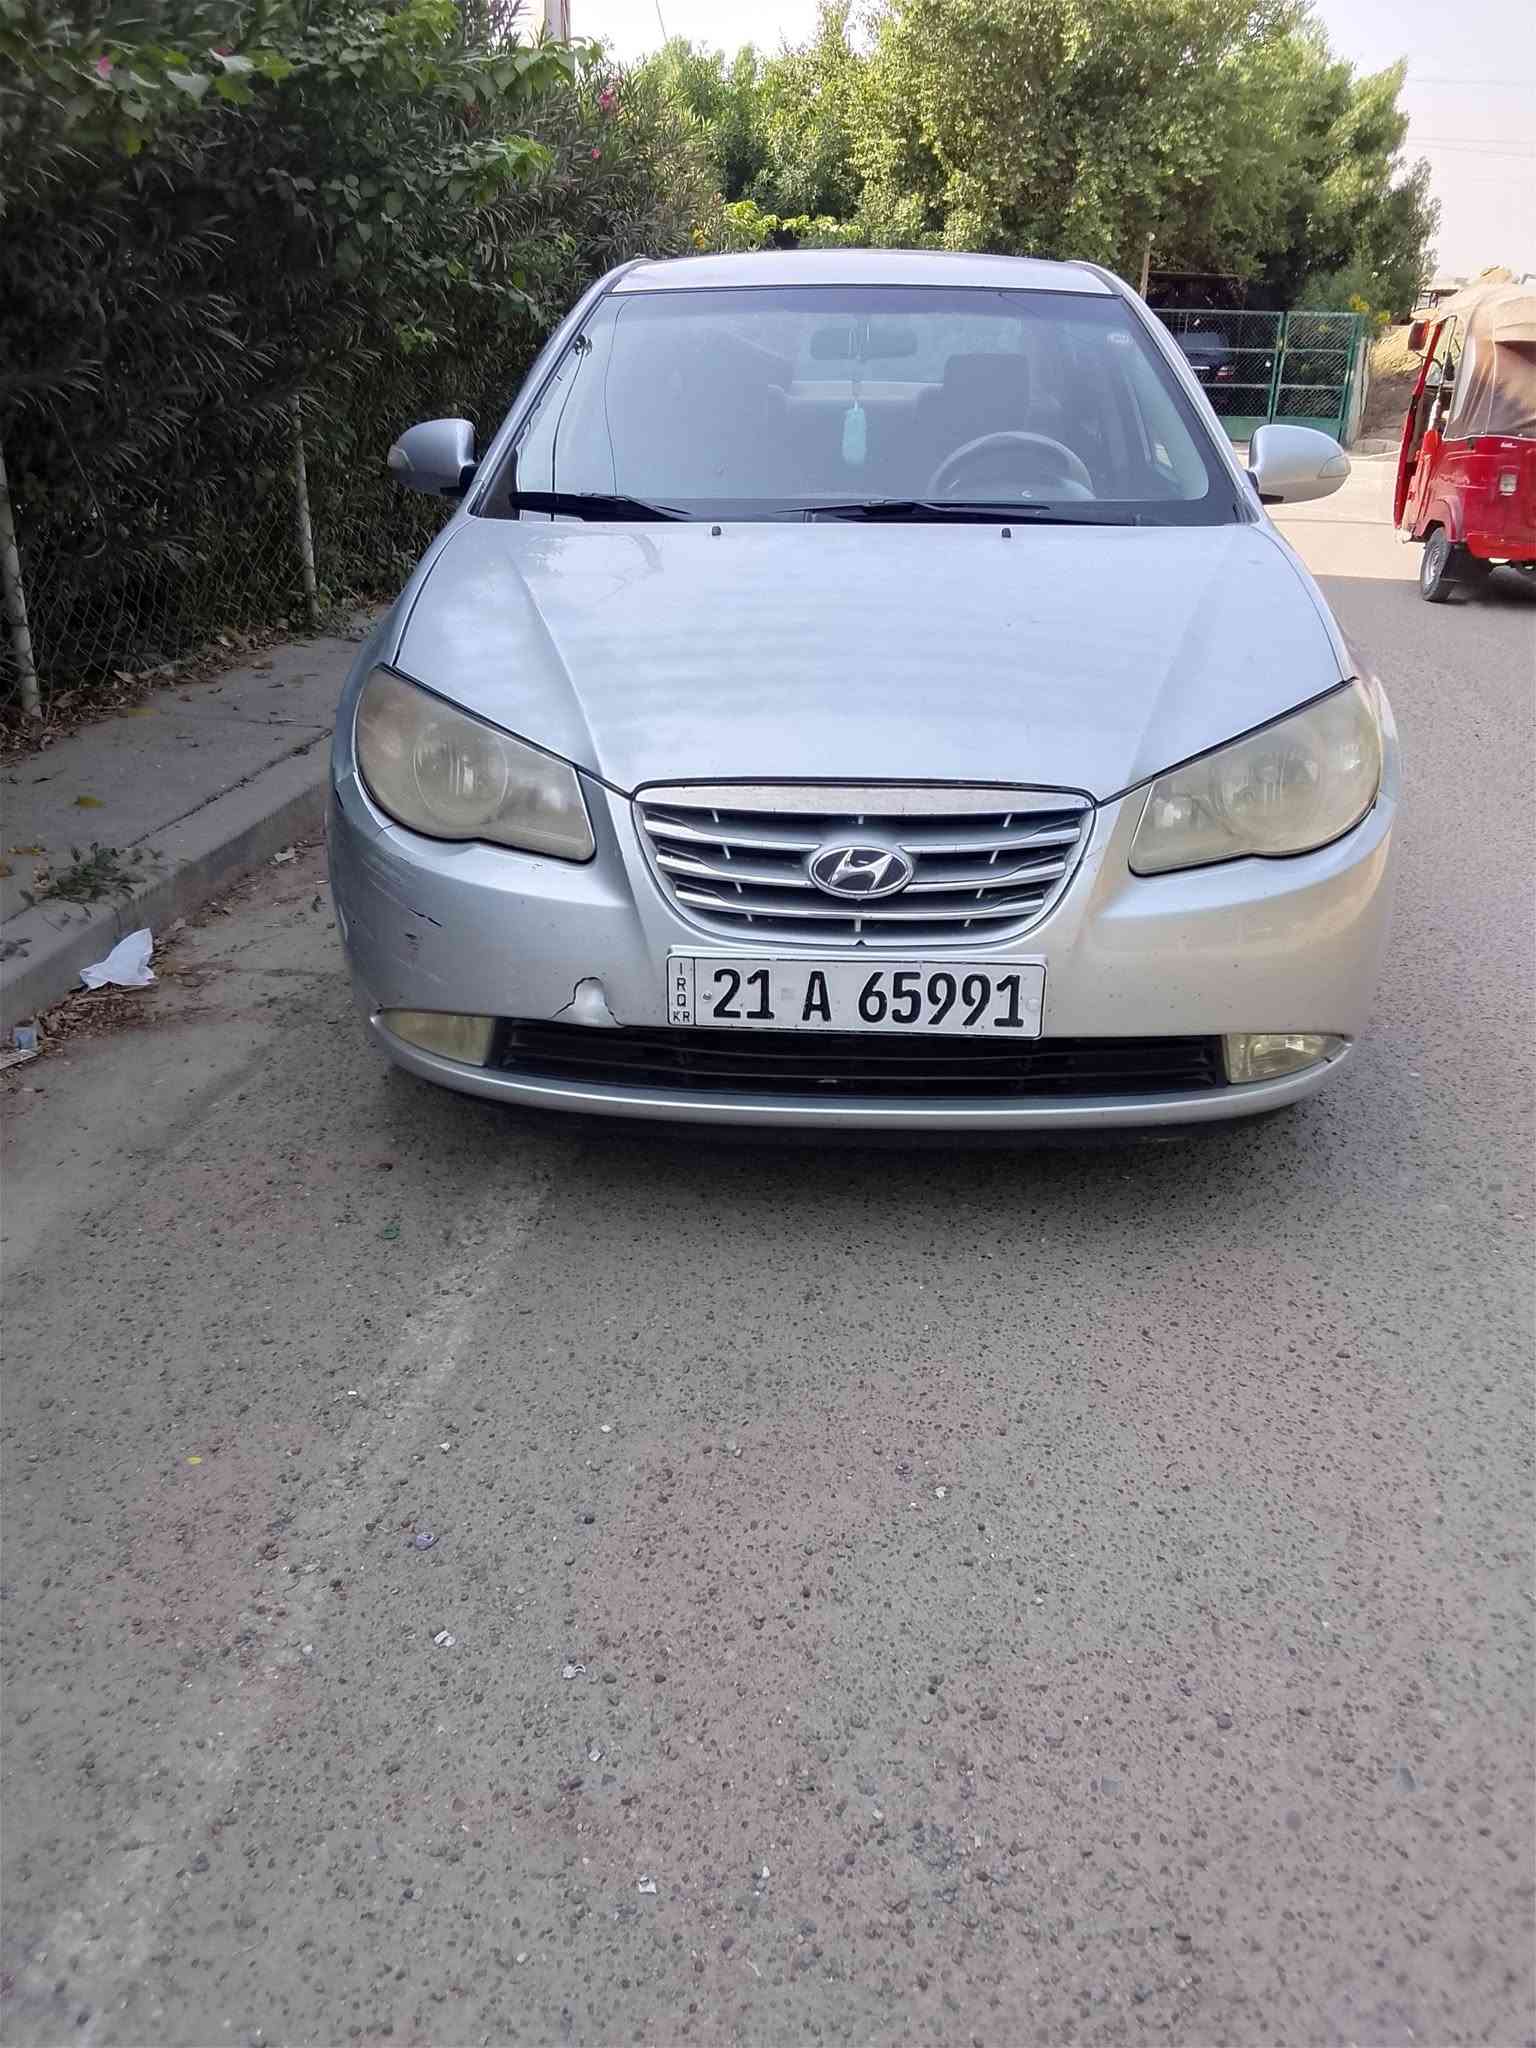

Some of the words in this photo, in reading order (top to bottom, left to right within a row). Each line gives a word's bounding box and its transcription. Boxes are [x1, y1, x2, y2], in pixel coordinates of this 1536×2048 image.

[713, 968, 775, 1020] 21
[801, 970, 832, 1023] A
[858, 971, 1024, 1028] 65991
[672, 1010, 691, 1023] KR
